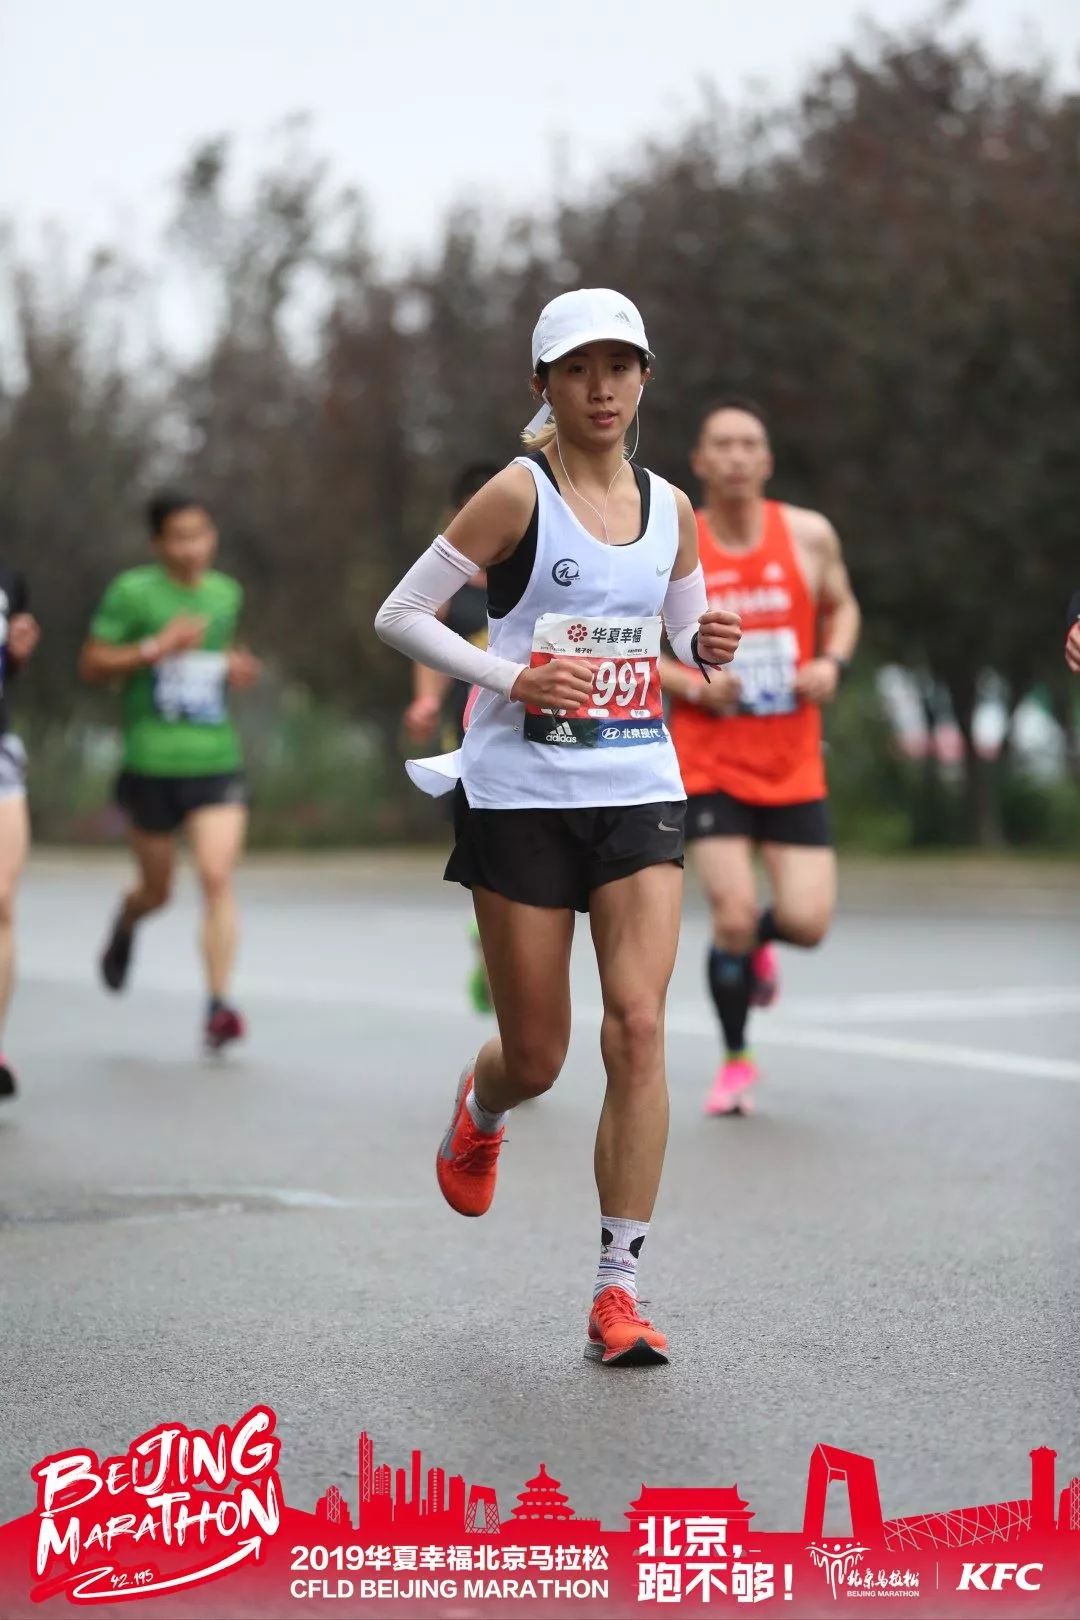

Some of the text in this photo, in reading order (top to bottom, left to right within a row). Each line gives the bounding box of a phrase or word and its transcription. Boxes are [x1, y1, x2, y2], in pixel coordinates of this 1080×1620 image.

[591, 627, 643, 644] 华夏幸福
[590, 661, 651, 707] 997
[545, 733, 577, 743] adidas
[622, 728, 660, 739] 北京现代
